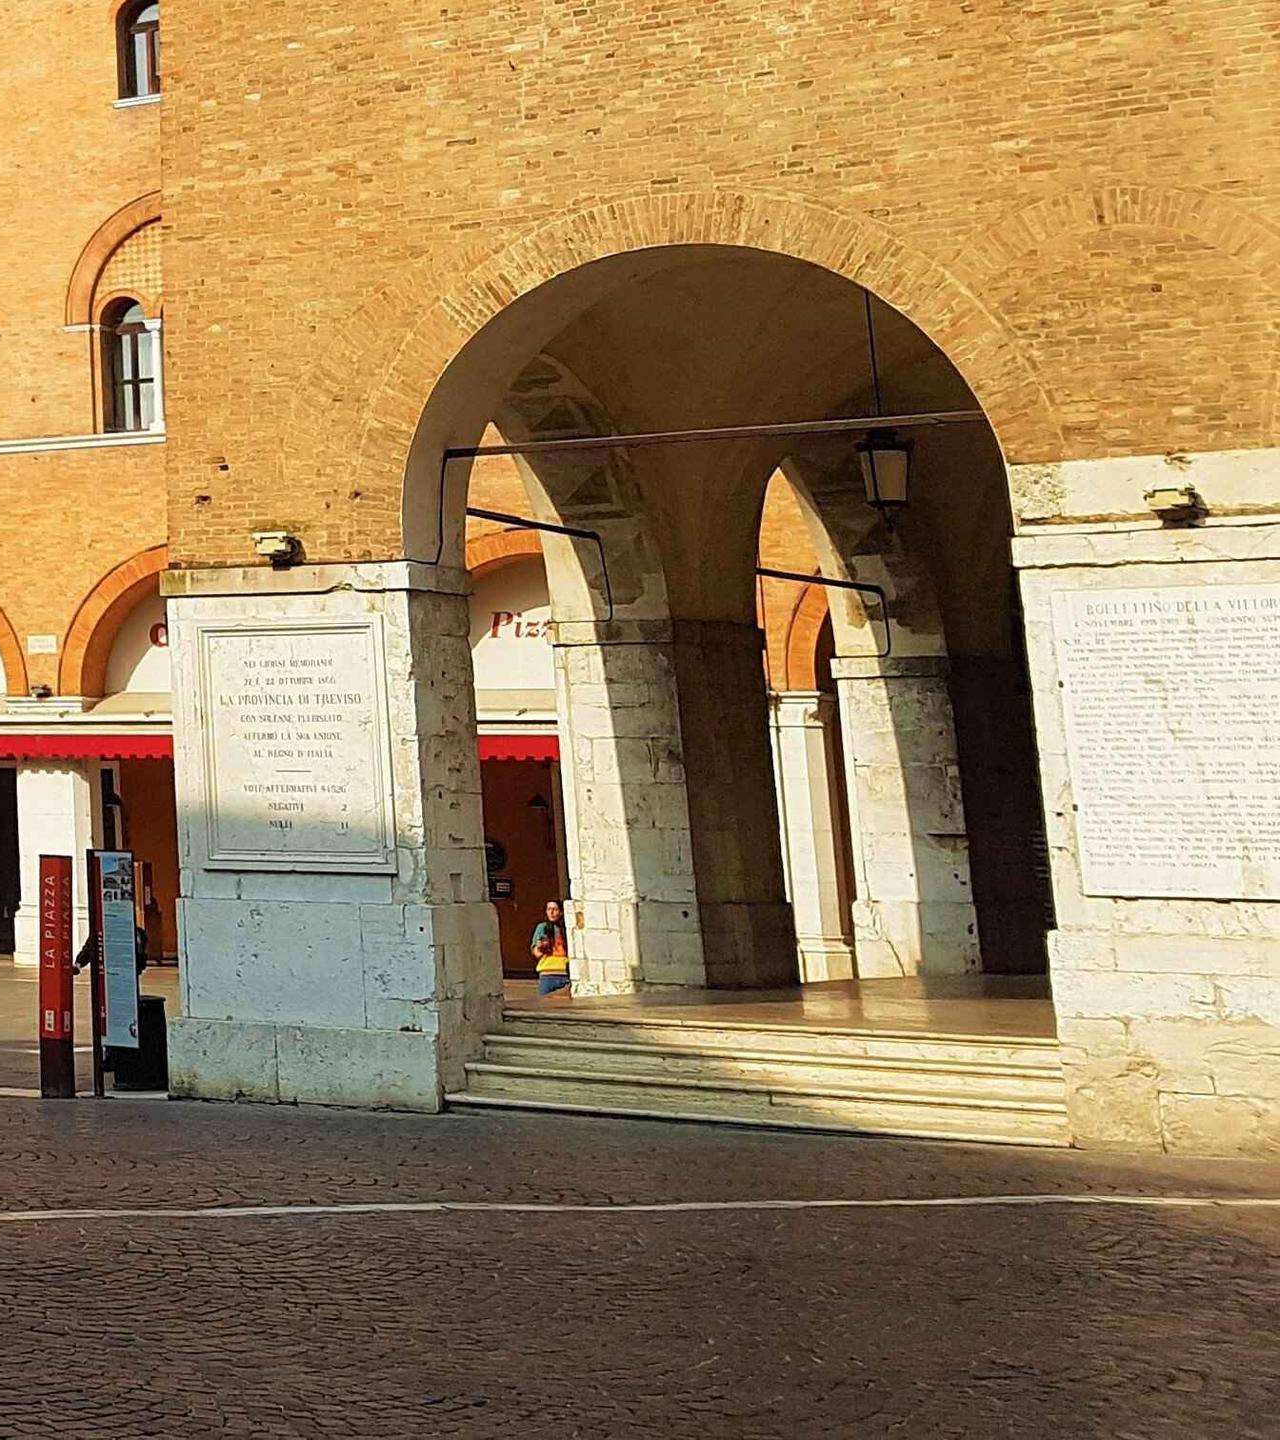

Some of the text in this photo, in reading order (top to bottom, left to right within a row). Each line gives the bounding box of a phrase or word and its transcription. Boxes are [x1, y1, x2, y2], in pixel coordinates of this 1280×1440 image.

[219, 693, 362, 706] LA PROVINCIA DI TREVISO
[44, 875, 56, 969] LA PIAZZA
